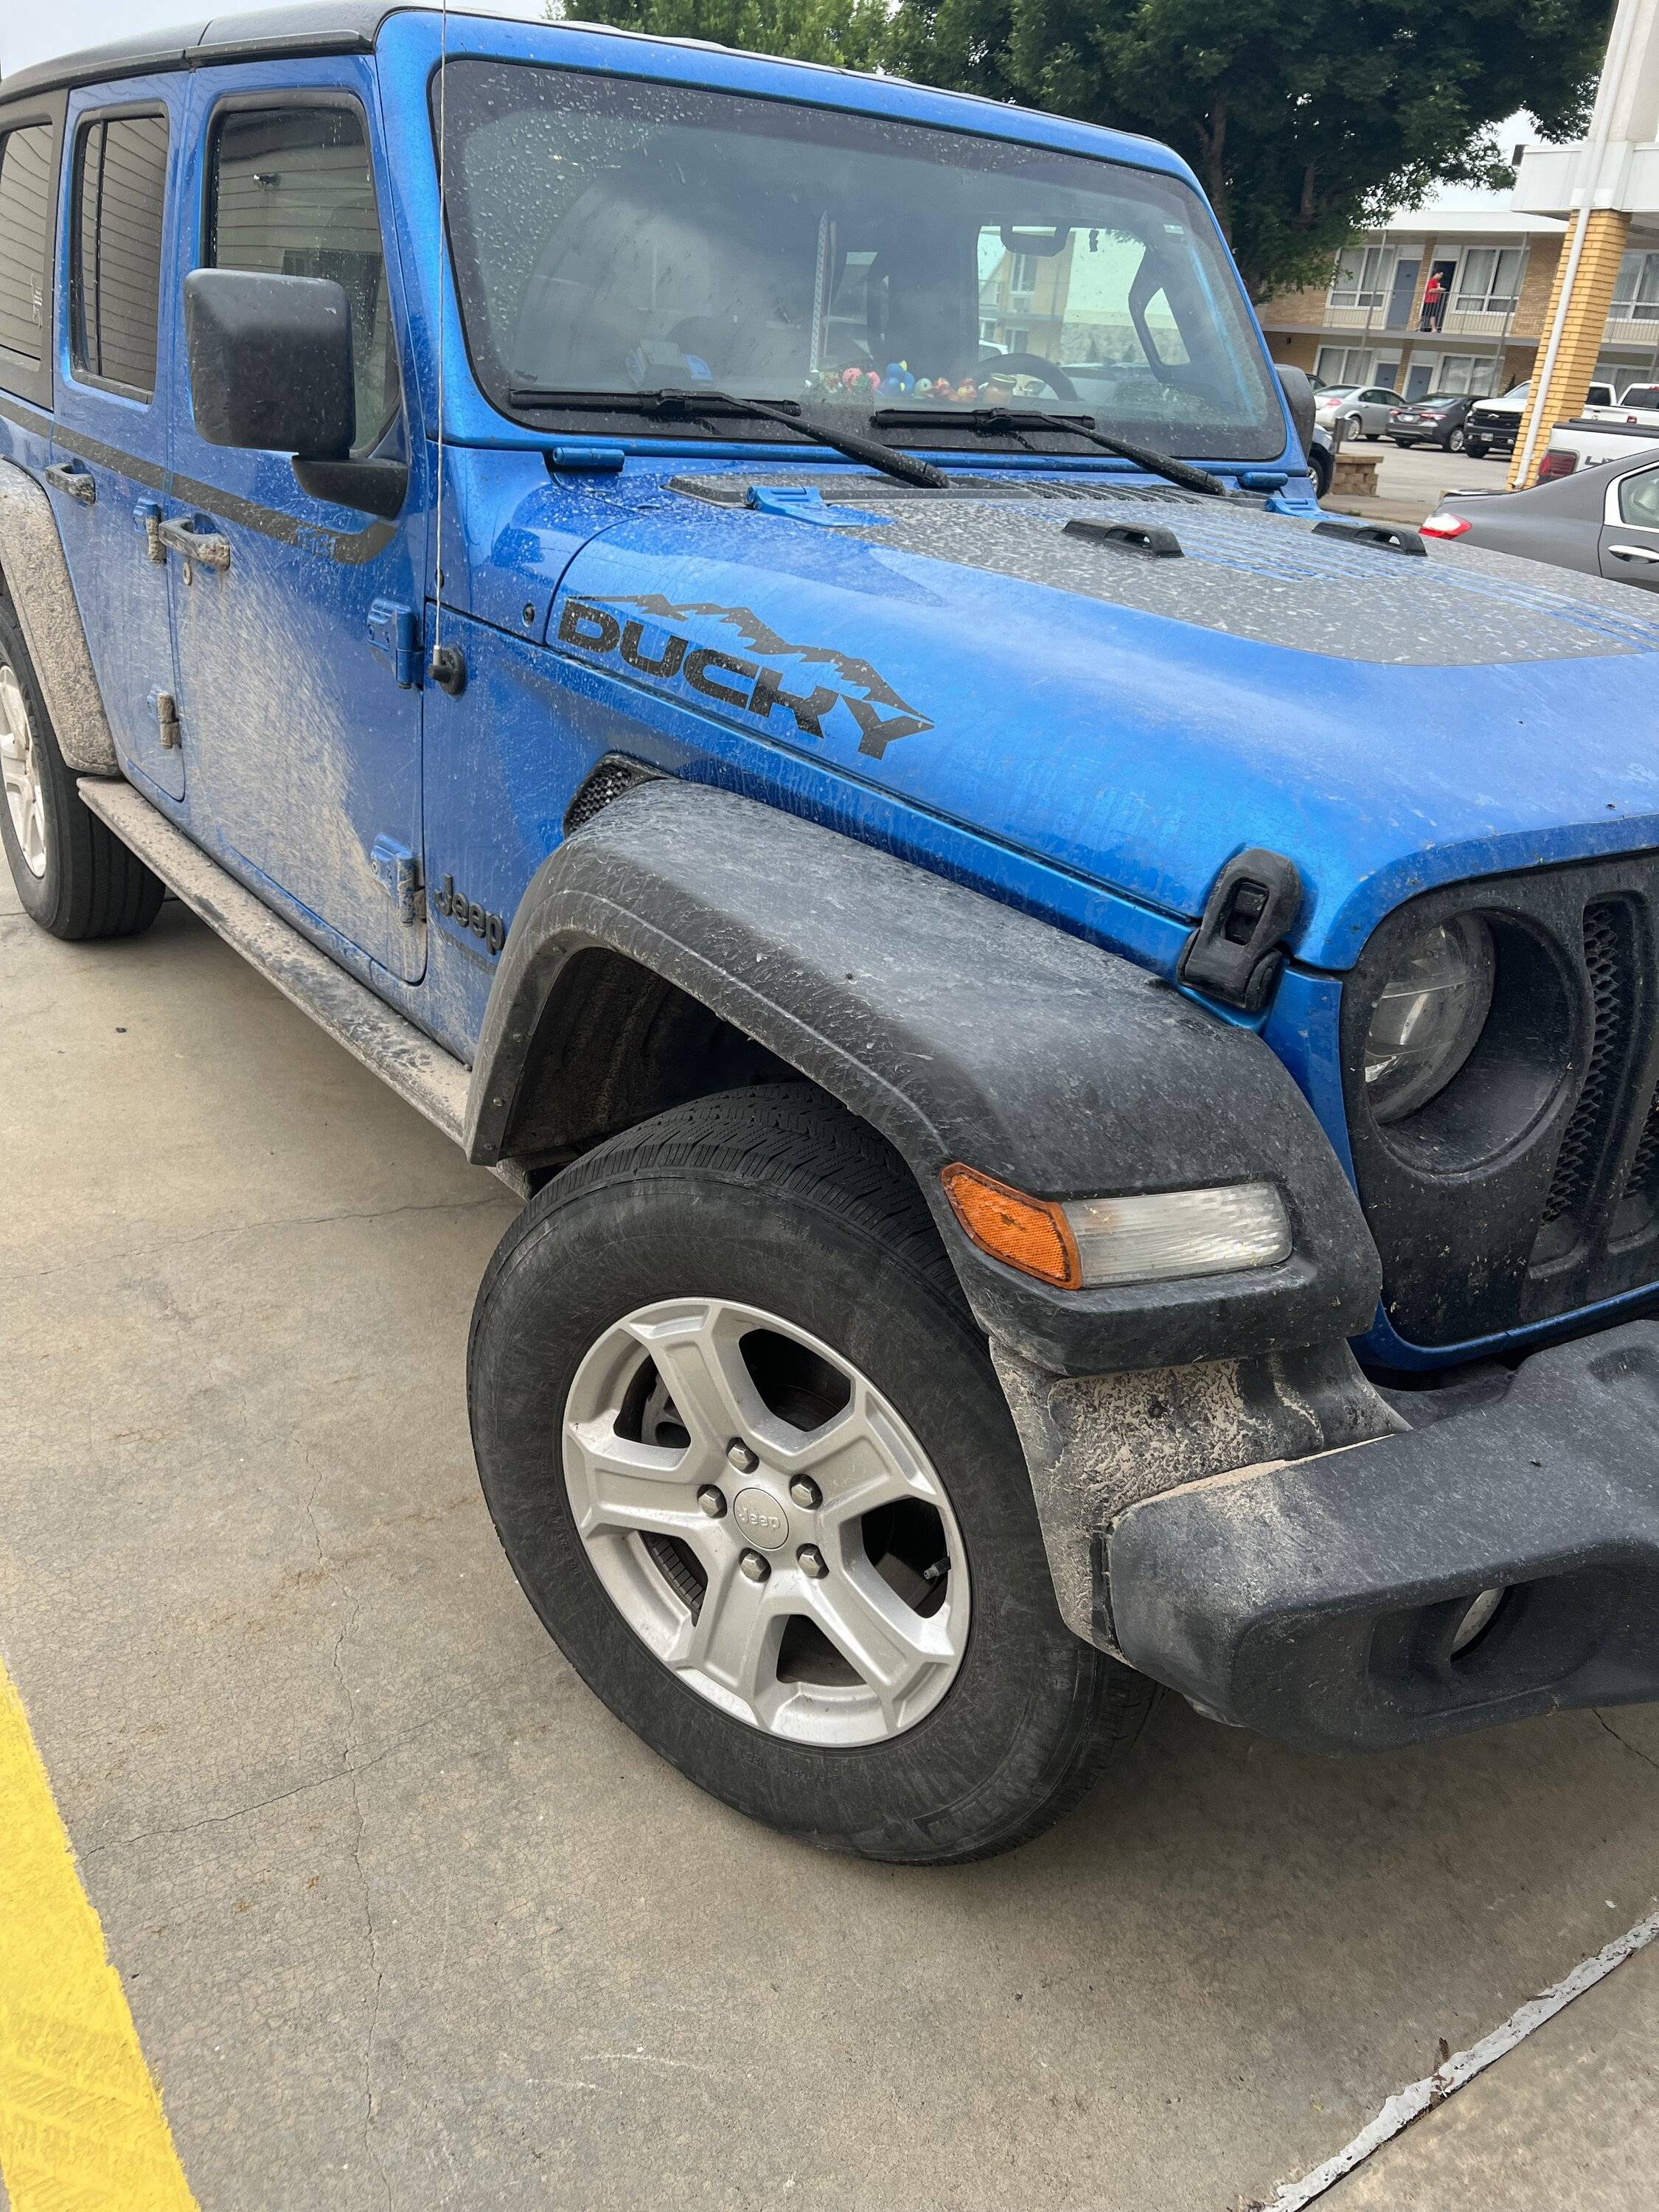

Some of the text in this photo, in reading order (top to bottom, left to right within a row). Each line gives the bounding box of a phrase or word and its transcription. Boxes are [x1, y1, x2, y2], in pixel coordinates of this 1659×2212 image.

[558, 598, 934, 760] DUCKY
[434, 873, 505, 956] Jeep
[739, 1508, 781, 1528] Jeep
